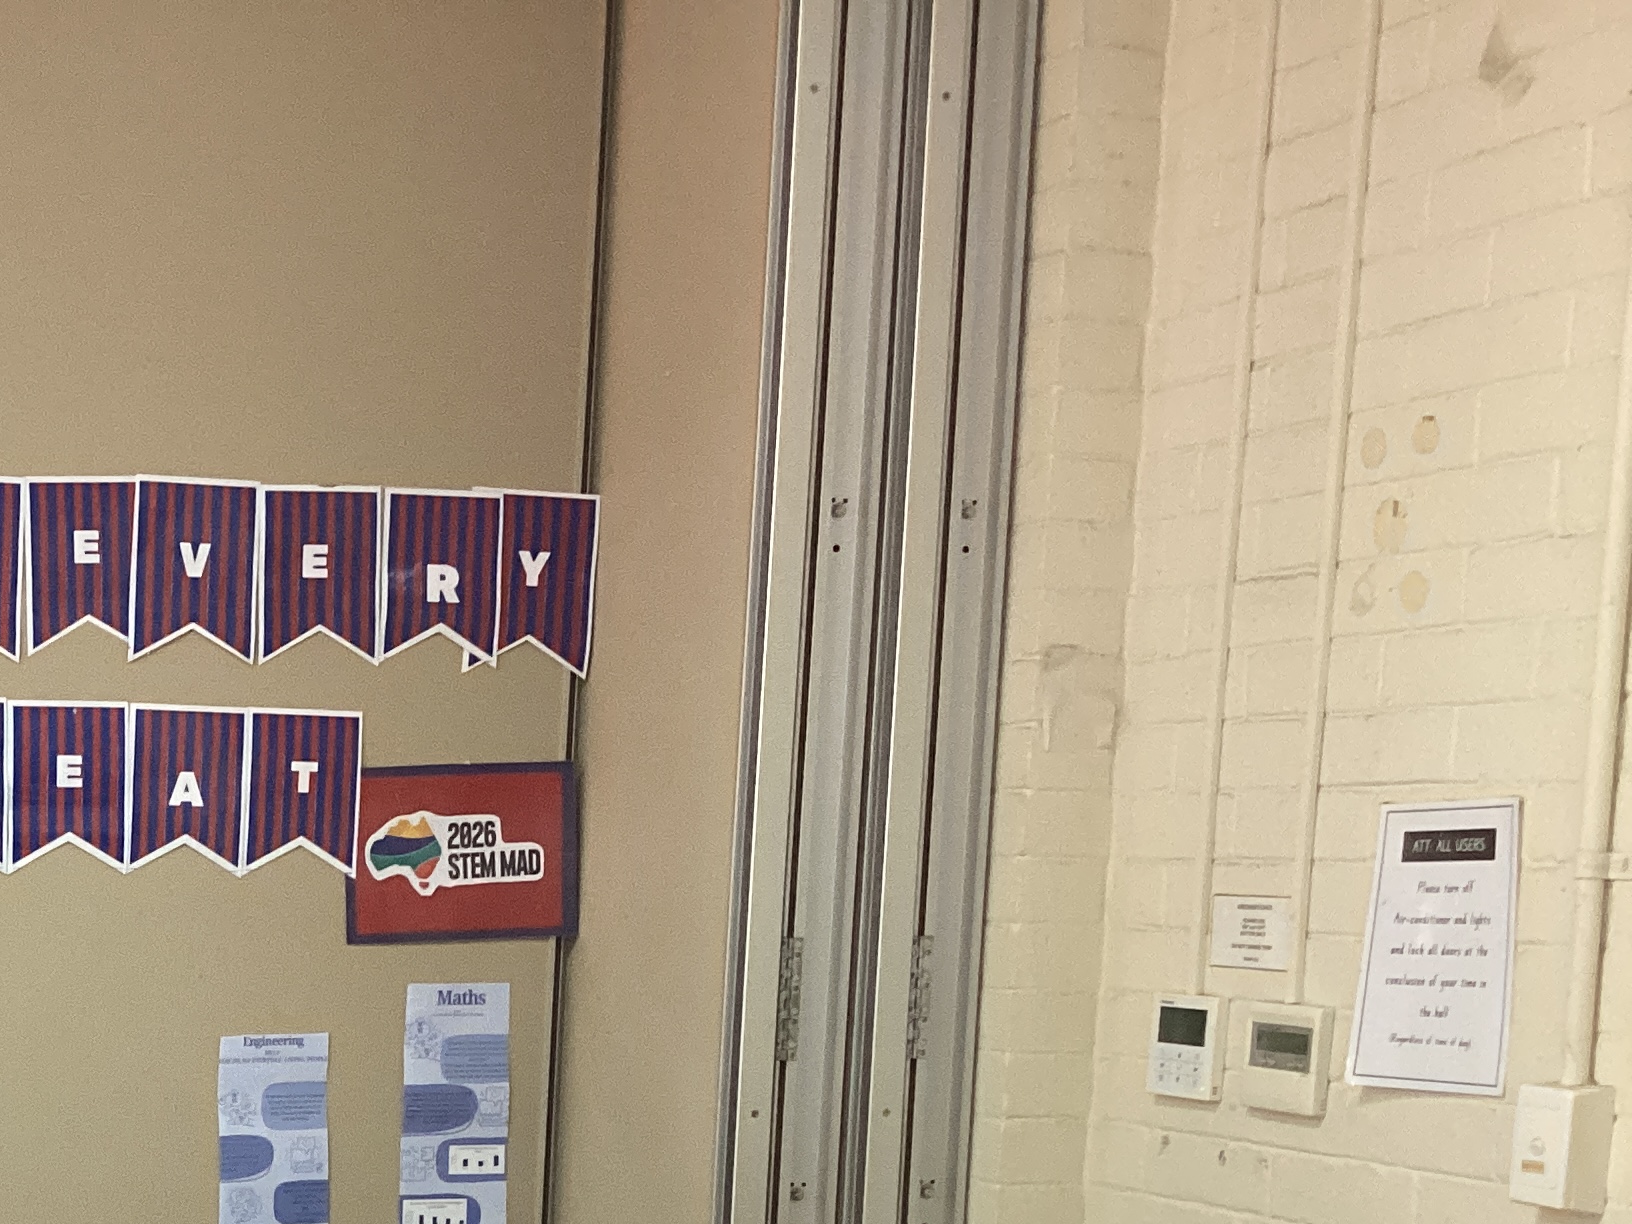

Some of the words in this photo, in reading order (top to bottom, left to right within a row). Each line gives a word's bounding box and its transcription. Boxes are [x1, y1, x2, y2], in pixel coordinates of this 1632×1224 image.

[72, 530, 551, 605] EVERY
[447, 821, 496, 849] 2026
[1436, 838, 1451, 852] ALL
[1455, 837, 1486, 852] USERS
[448, 851, 496, 880] STEM
[500, 849, 541, 877] MAD
[1391, 942, 1405, 955] and
[437, 989, 486, 1006] Maths
[243, 1036, 305, 1049] Engineering
